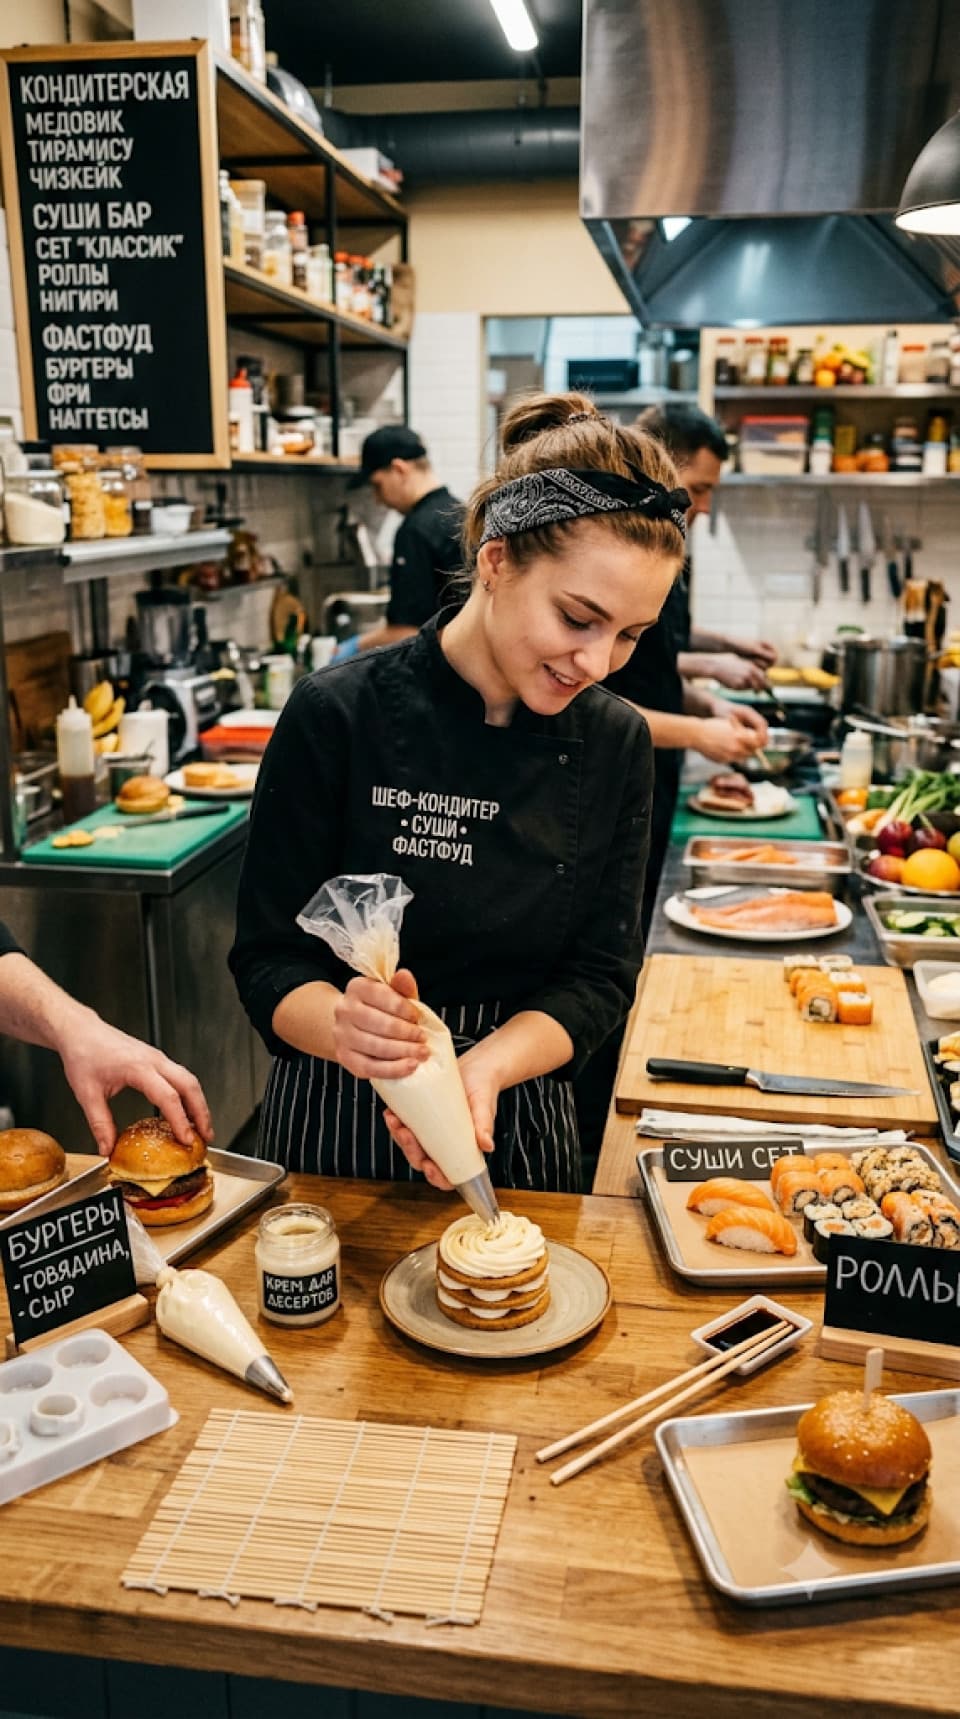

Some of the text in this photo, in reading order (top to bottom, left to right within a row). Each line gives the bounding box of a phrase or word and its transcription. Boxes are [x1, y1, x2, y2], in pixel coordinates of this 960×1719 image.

[20, 70, 190, 106] КОНДИТЕРСКАЯ
[26, 110, 125, 137] МЕДОВИК
[27, 137, 134, 162] ТИРАМИСУ
[29, 161, 123, 190] ЧИЗКЕЙК
[33, 201, 152, 230] СУШИ БАР
[36, 236, 72, 260] СЕТ
[38, 263, 109, 286] РОЛЛЫ
[40, 289, 119, 312] НИГИРИ
[42, 322, 154, 354] ФАСТФУД
[45, 357, 134, 379] БУРГЕРЫ
[47, 382, 91, 405] ФРИ
[49, 408, 149, 430] НАГГЕТСЫ
[371, 786, 500, 821] ШЕФ-КОНДИТЕР
[392, 835, 474, 866] ФАСТФУД
[669, 1148, 744, 1171] СУШИ
[7, 1196, 121, 1262] БУРГЕРЫ
[265, 1275, 303, 1294] КРЕМ
[836, 1255, 960, 1308] РОЛЛЫ
[267, 1286, 335, 1310] ДЕСЕРТОВ
